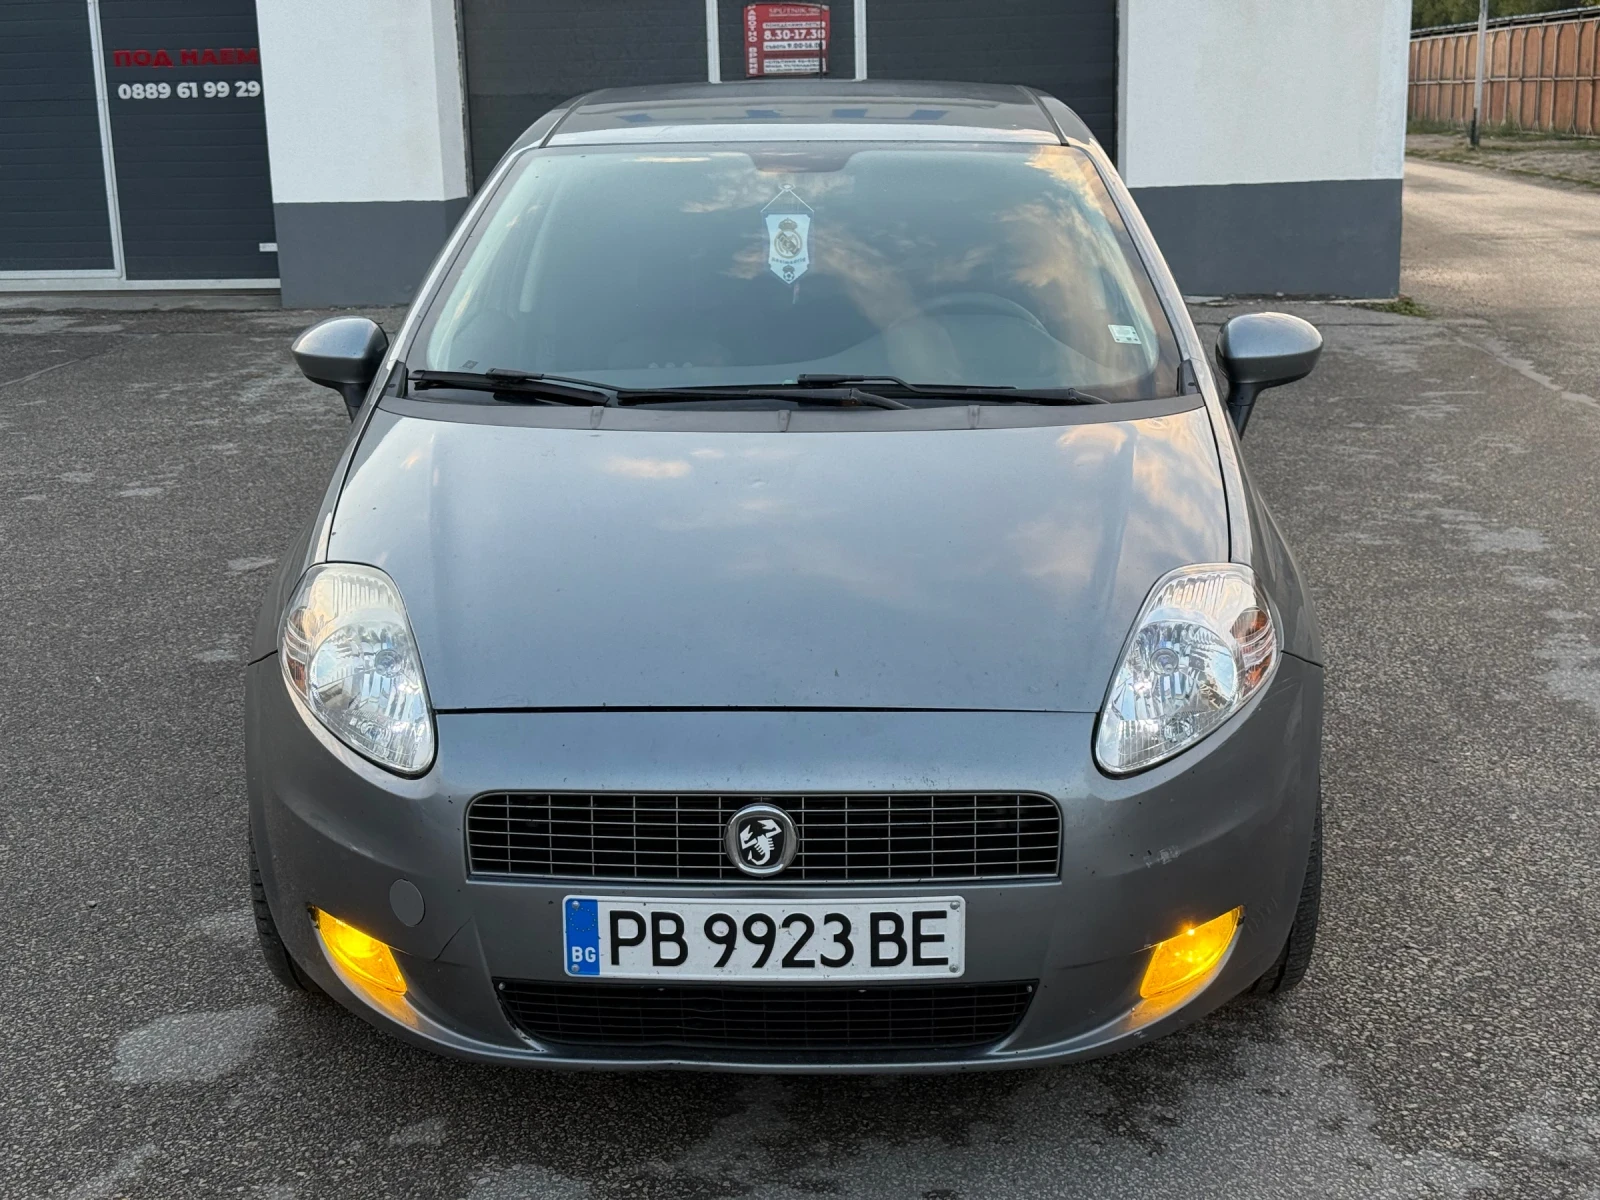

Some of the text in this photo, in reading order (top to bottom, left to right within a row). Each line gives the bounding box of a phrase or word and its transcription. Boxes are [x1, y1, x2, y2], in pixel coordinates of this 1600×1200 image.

[763, 29, 826, 40] 8.30-17.30
[113, 47, 259, 69] ПОД НАЕМ
[117, 80, 261, 100] 0889 61 99 29
[609, 910, 949, 969] PB 9923 BE
[571, 946, 596, 963] BG
